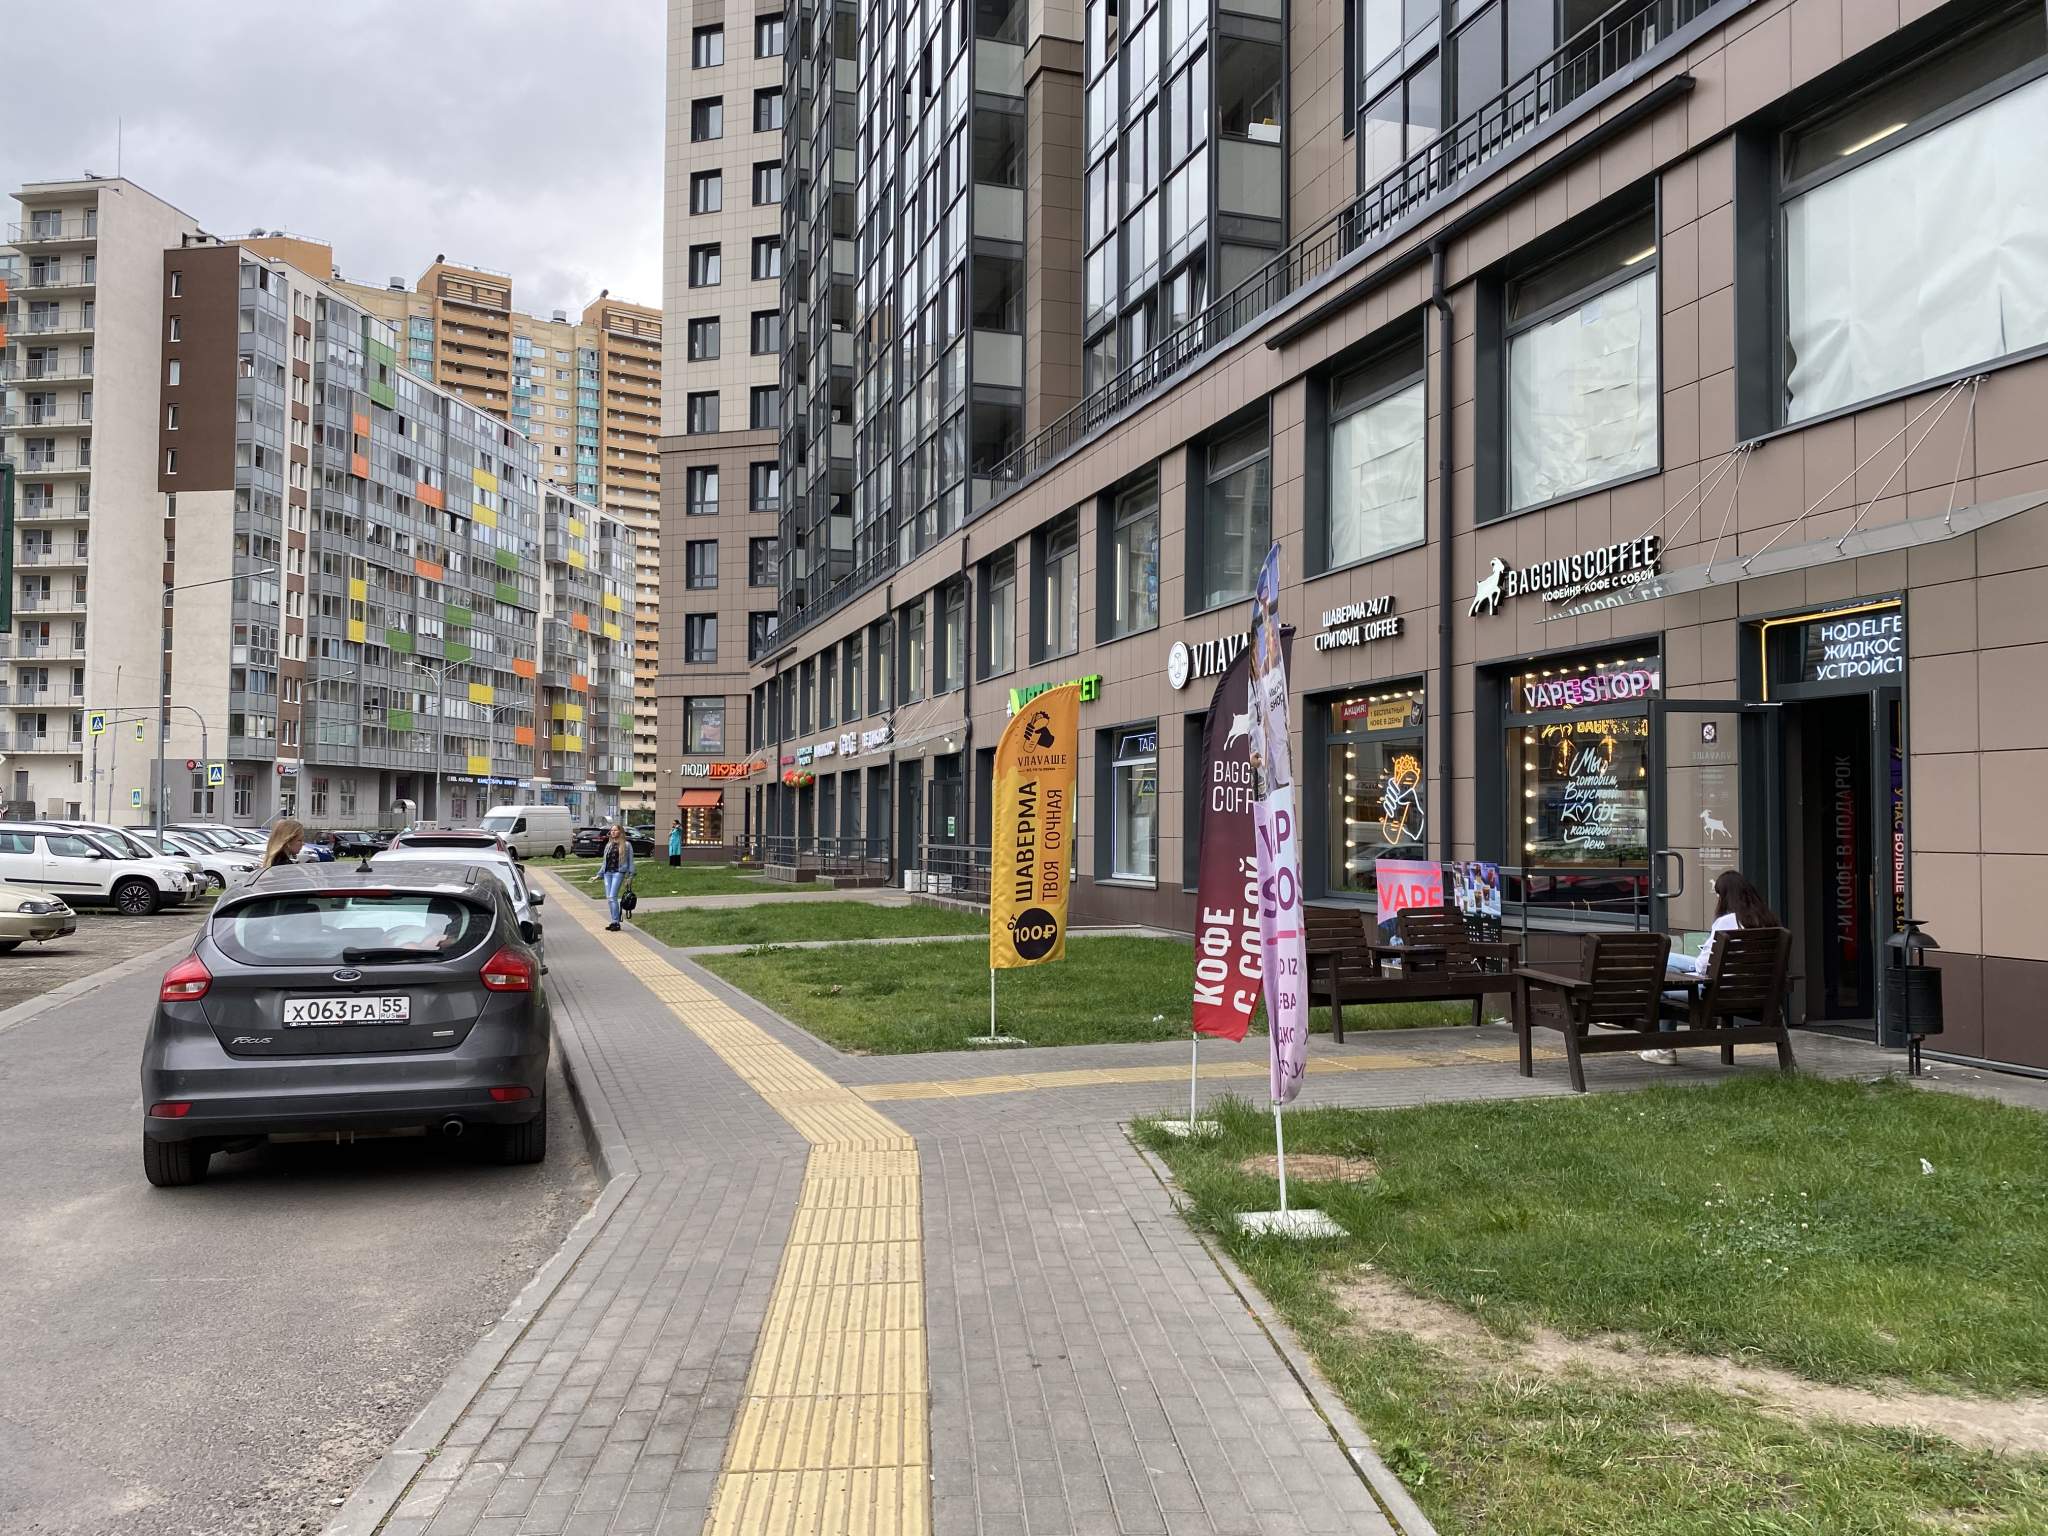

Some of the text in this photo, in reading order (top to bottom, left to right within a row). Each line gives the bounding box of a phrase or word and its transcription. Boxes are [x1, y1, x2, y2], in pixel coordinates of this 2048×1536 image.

[1322, 595, 1390, 627] ШАВЕРМА 24/7
[1314, 617, 1399, 652] СТРИТФУД COFFEE
[1821, 623, 1861, 642] HQD
[1523, 671, 1647, 708] VAPE SHOP
[1137, 737, 1157, 753] ТАБ
[1213, 760, 1251, 784] BAGG
[1212, 785, 1254, 815] COFF
[1016, 781, 1037, 903] ШАВЕРМА
[1042, 789, 1063, 901] ТВОЯ СОЧНАЯ
[1193, 907, 1235, 1007] КОФЕ
[381, 998, 402, 1013] 55
